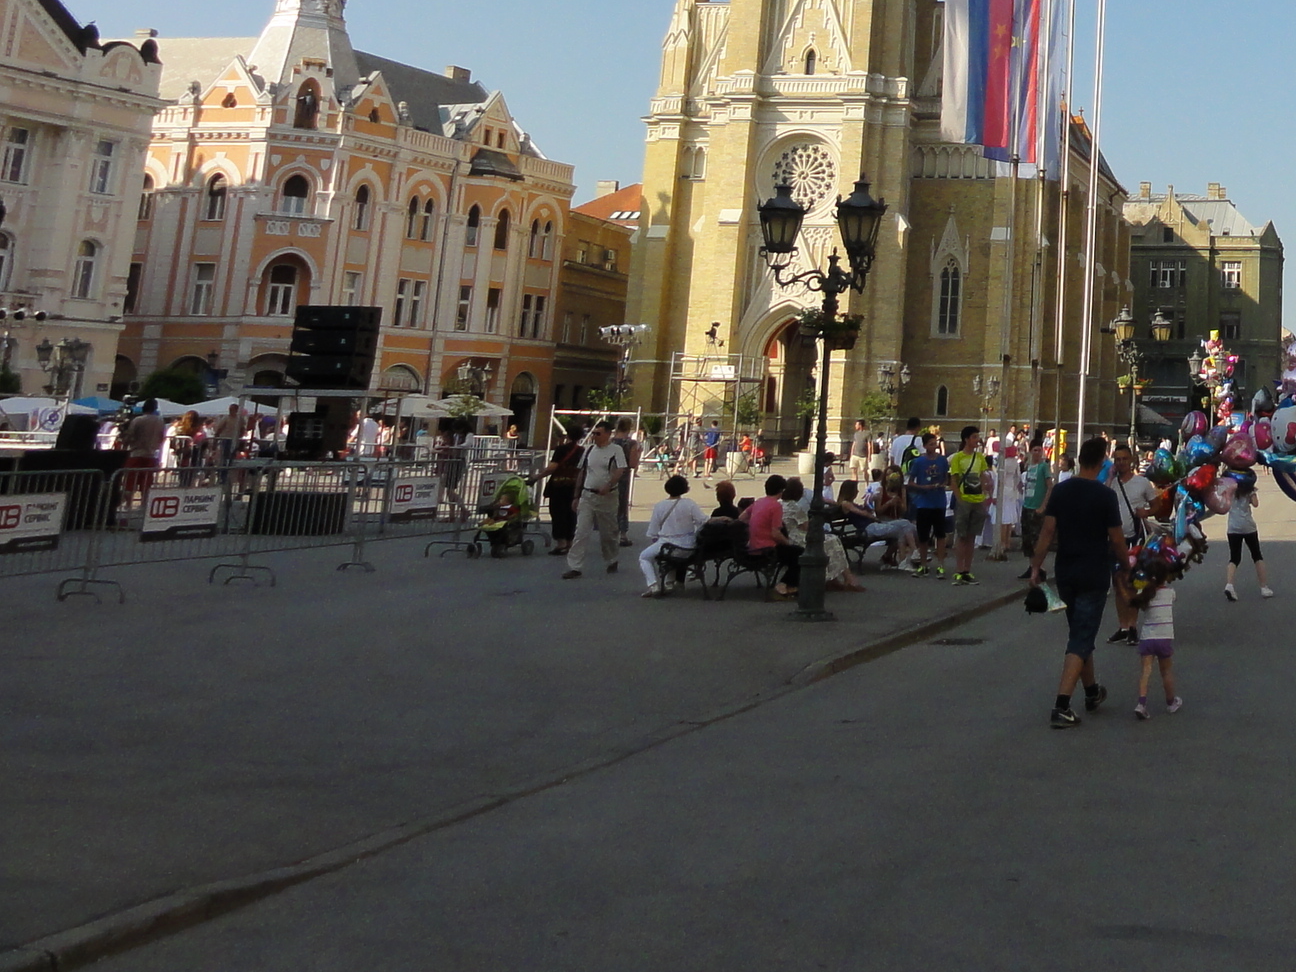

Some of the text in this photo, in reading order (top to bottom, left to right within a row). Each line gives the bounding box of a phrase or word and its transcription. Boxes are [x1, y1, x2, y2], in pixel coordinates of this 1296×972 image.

[183, 494, 217, 504] ПАРКИНГ
[182, 503, 210, 514] СЕРВИС
[24, 512, 53, 524] СЕРВИС
